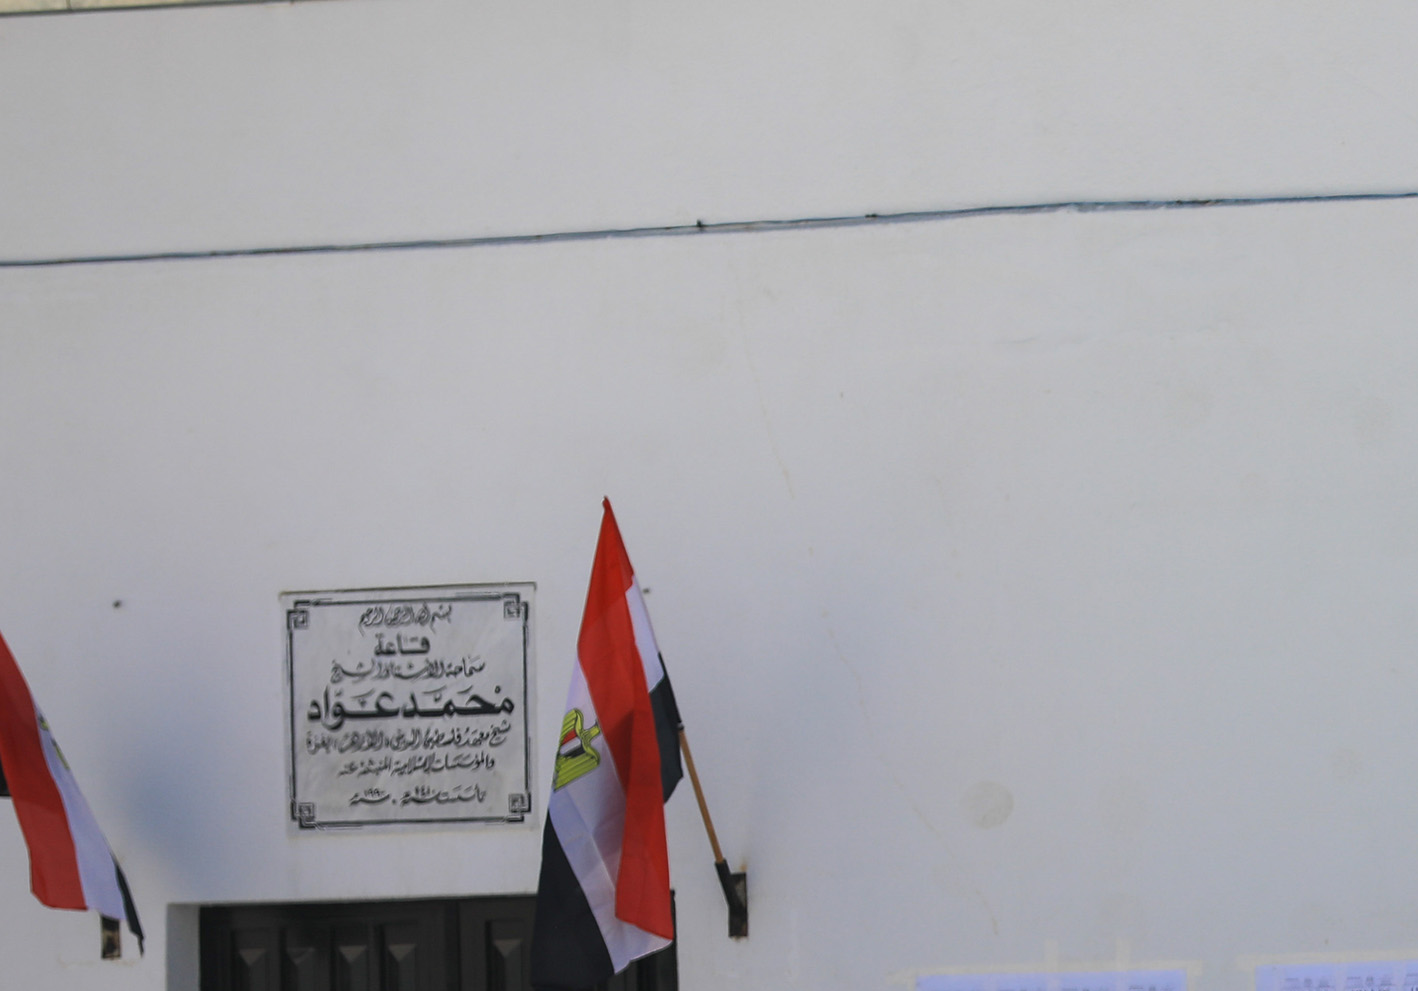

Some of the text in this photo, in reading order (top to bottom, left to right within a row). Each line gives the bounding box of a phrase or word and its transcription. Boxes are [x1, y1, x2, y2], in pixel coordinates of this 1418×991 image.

[429, 604, 452, 634] بسم
[374, 633, 431, 656] قاعة
[330, 658, 382, 684] الشيخ
[445, 655, 485, 678] سماحة
[488, 719, 512, 747] شيخ
